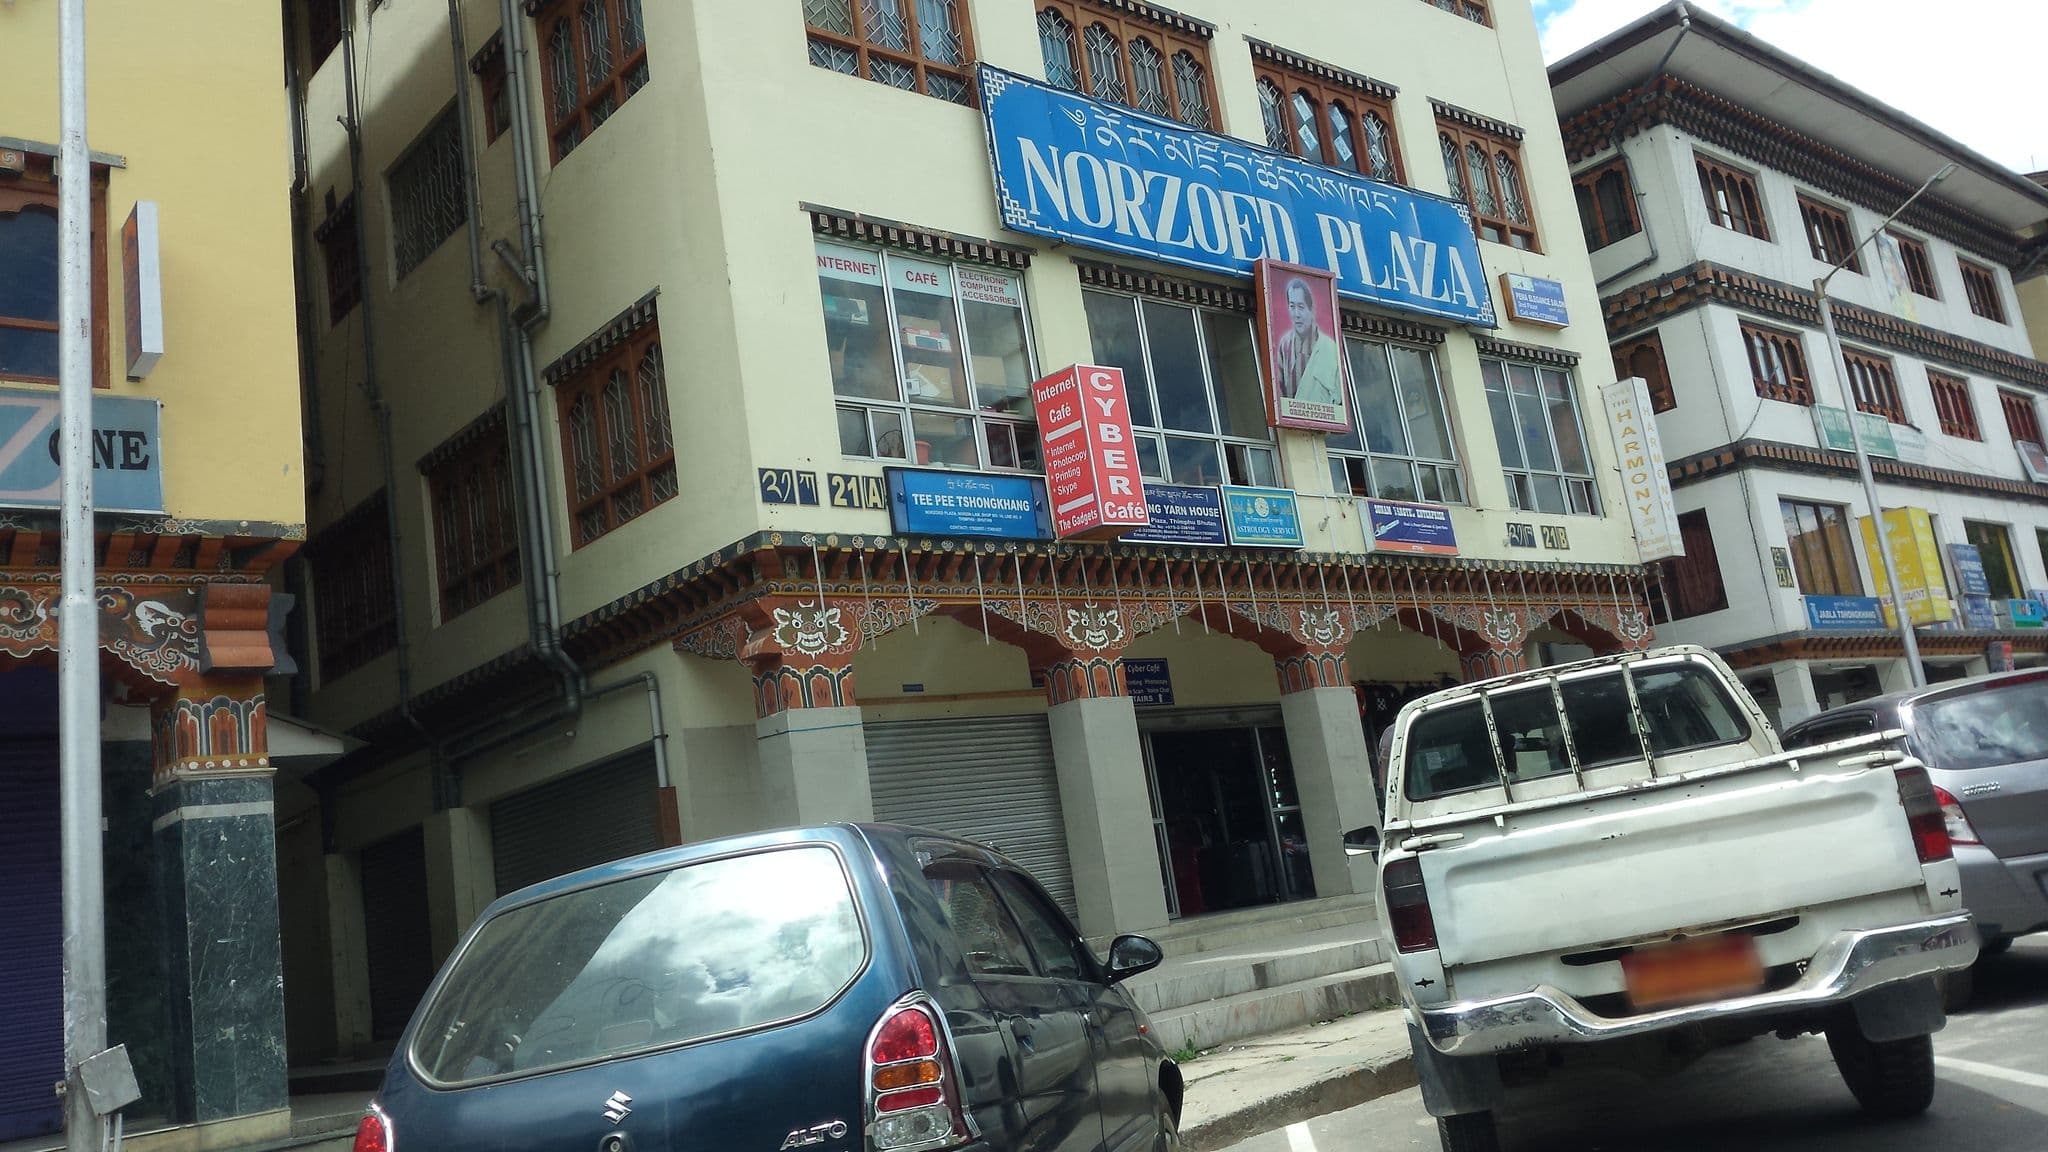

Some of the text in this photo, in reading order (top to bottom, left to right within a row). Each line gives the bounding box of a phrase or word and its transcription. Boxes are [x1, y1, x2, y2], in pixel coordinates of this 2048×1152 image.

[1017, 136, 1479, 309] NORZOED PLAZA
[817, 255, 877, 276] NTERNET
[905, 270, 939, 286] CAFÉ
[958, 271, 1009, 286] ELECTRONIC
[960, 280, 1004, 294] COMPUTER
[962, 290, 1018, 306] ACCESSORIES
[1036, 375, 1076, 404] Internet
[1049, 402, 1072, 424] Café
[1090, 372, 1133, 496] CYBER
[1050, 440, 1077, 457] Internet
[1052, 450, 1088, 470] Photocopy
[1615, 408, 1653, 517] HARMONY
[1055, 469, 1082, 484] Printing
[1057, 483, 1079, 497] Skype
[912, 493, 1030, 512] TEE PEE TSHONGKHANG
[1104, 501, 1146, 520] Café
[1163, 503, 1188, 516] YARN
[1188, 506, 1220, 518] HOUSE
[1058, 510, 1099, 532] The Gadgets
[1127, 664, 1145, 674] Cyber
[779, 1120, 848, 1151] ALTO
